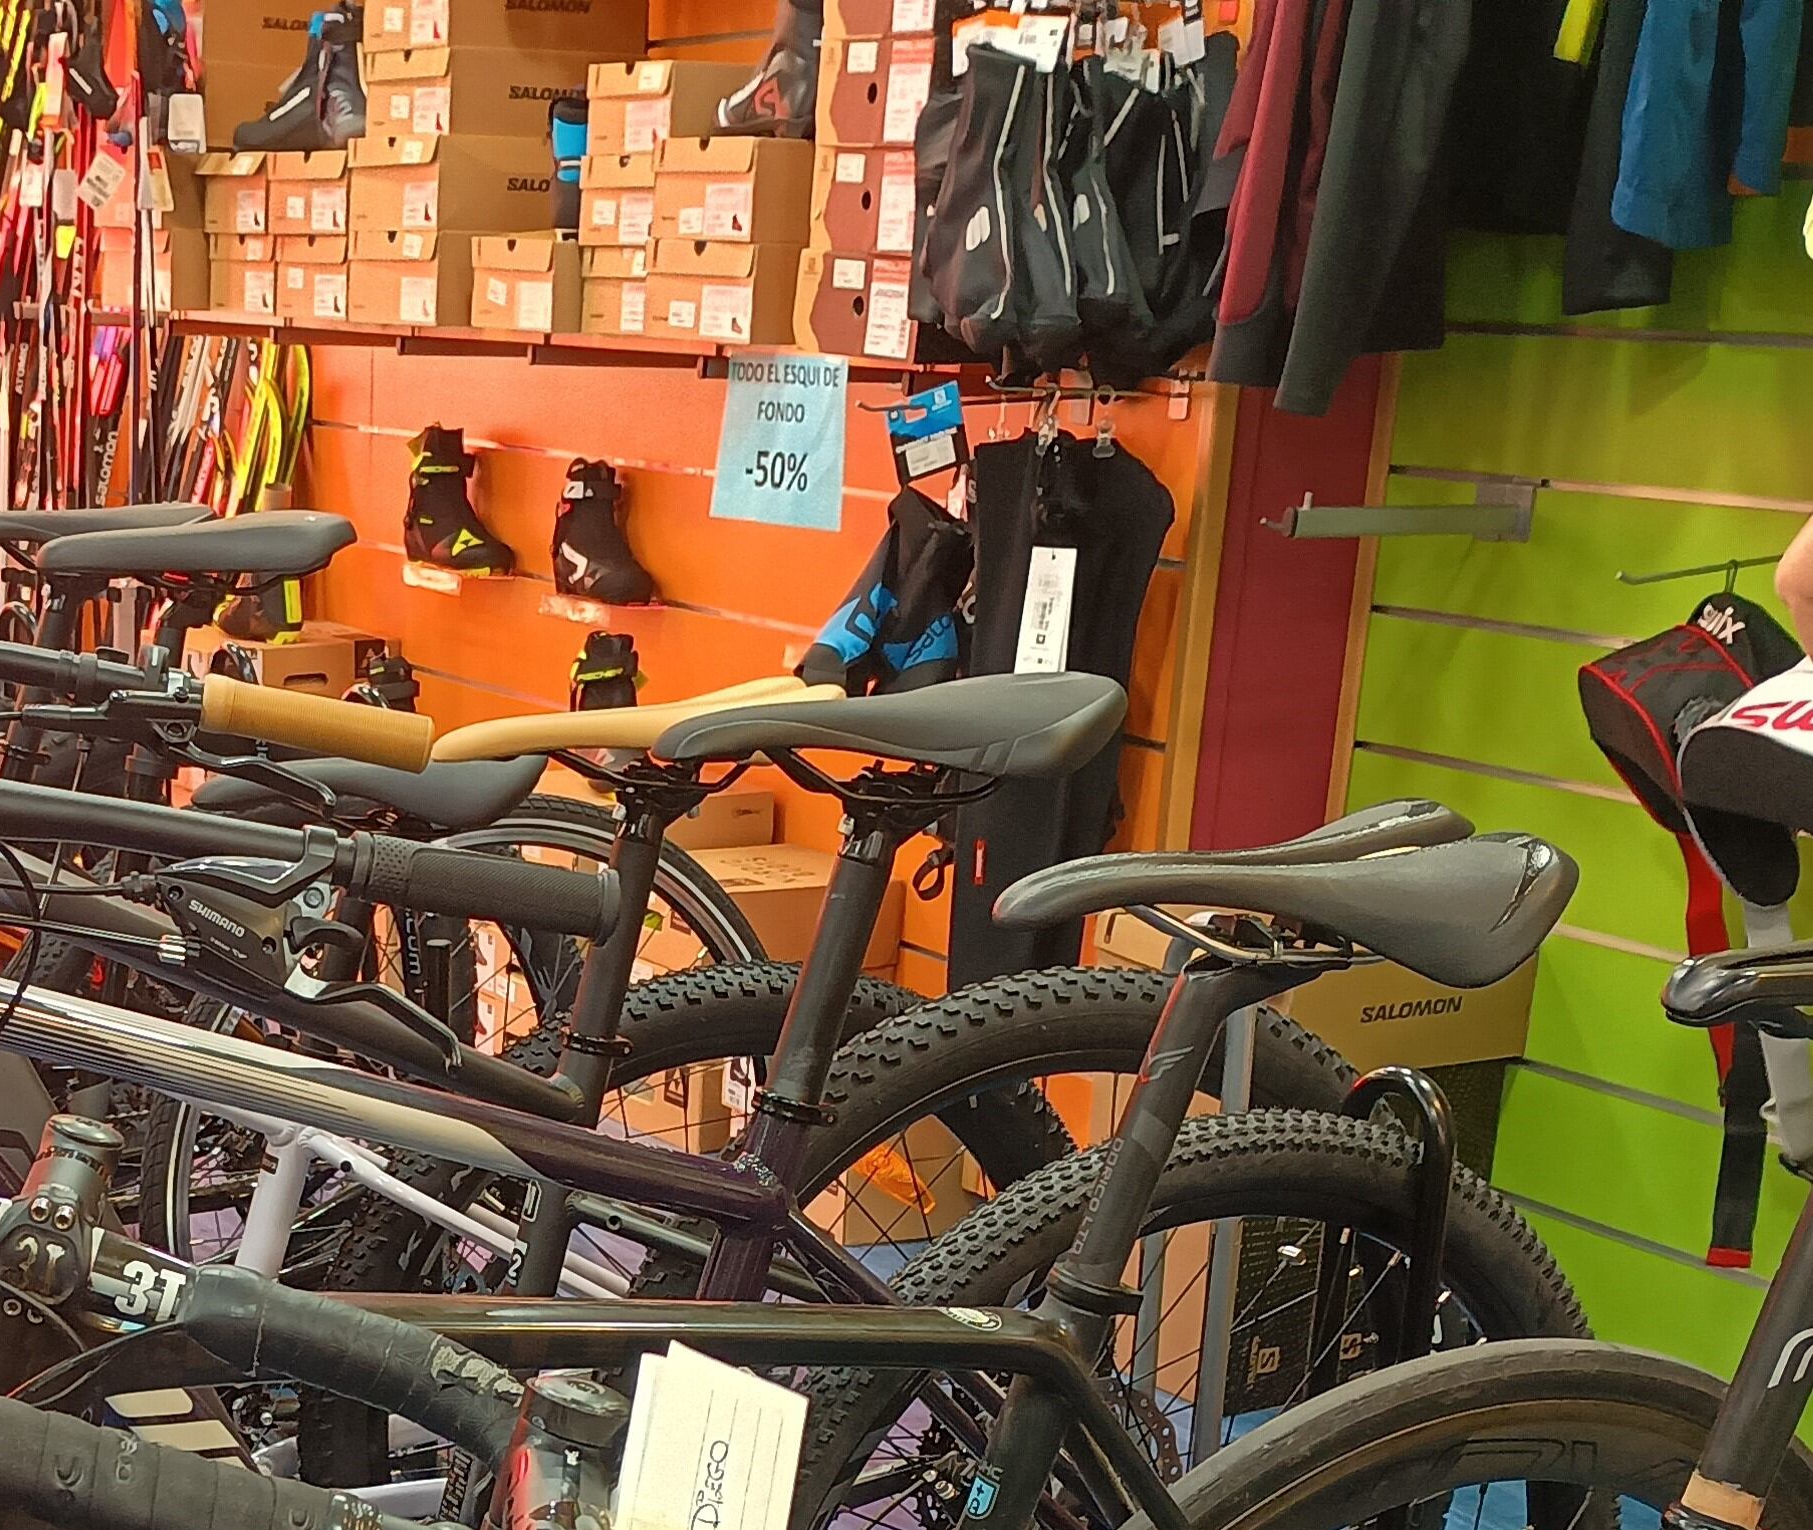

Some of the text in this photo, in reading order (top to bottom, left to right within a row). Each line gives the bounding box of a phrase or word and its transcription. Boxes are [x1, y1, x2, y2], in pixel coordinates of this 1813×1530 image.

[506, 178, 550, 193] SALO
[731, 362, 841, 388] TODO EL ESQUI DE
[757, 401, 806, 423] FONDO
[745, 450, 808, 492] -50%
[188, 898, 246, 938] SHIMANO
[1359, 995, 1464, 1024] SALOMON
[114, 1258, 187, 1323] 3T
